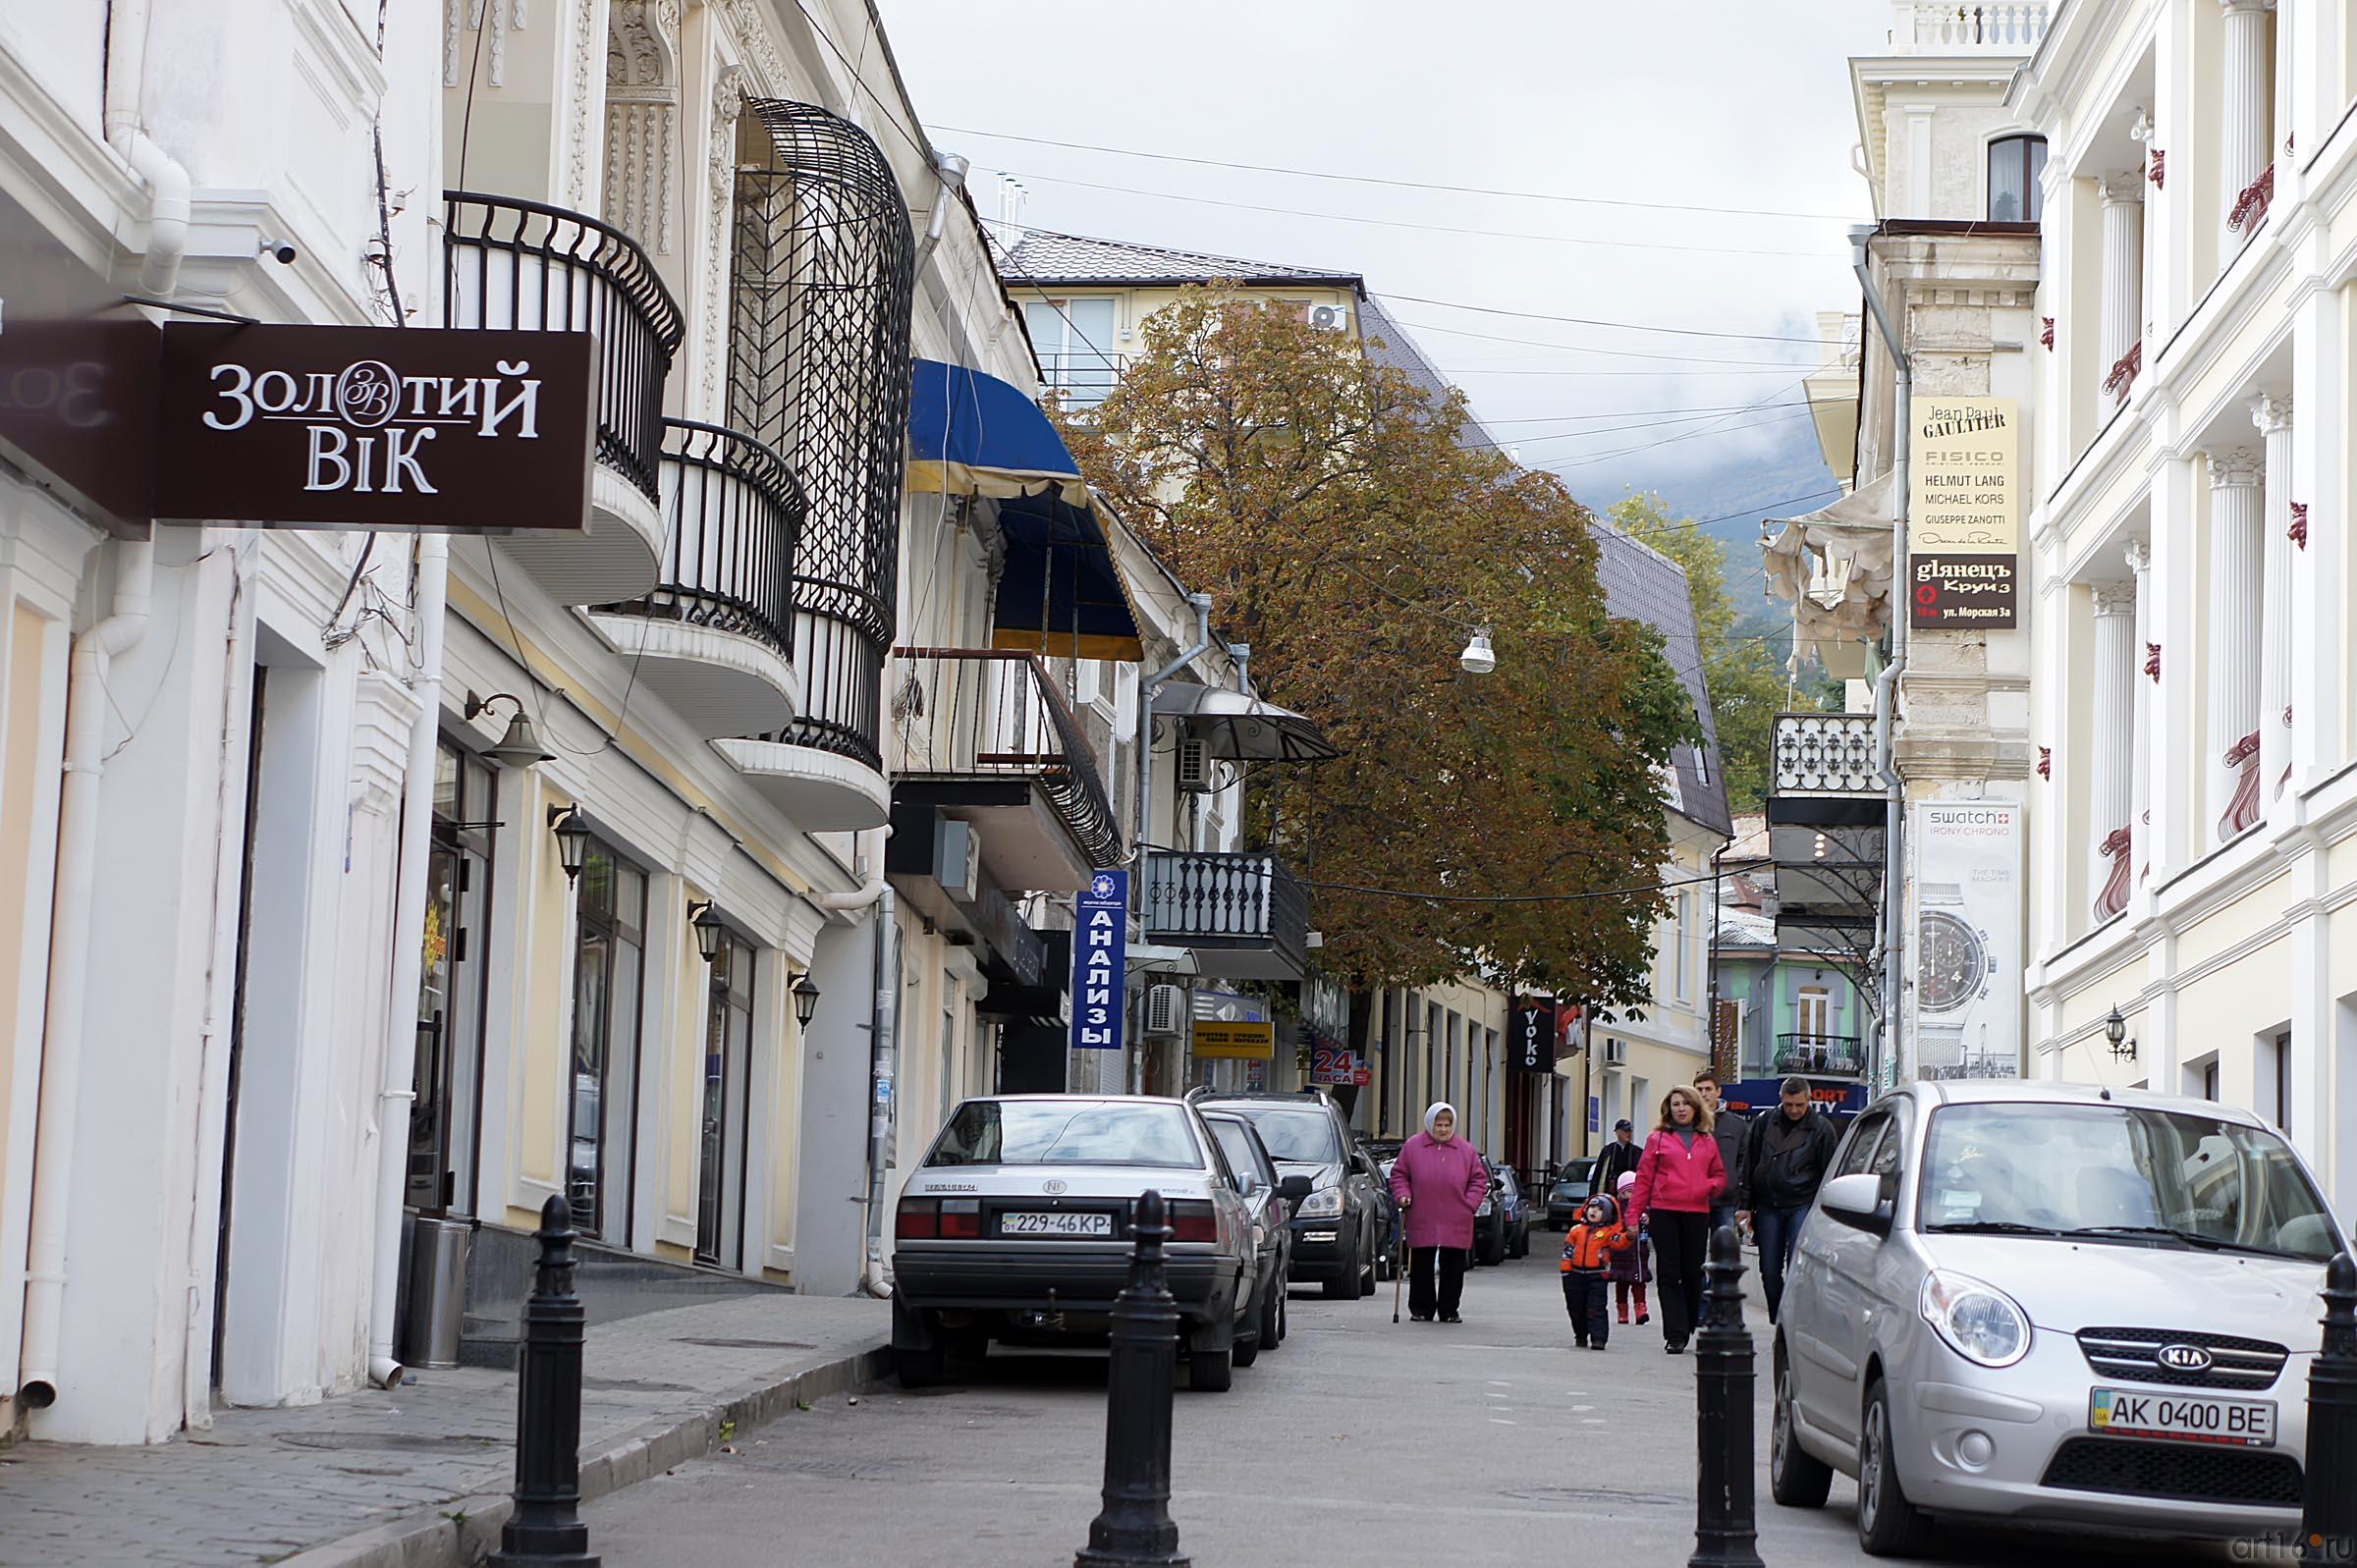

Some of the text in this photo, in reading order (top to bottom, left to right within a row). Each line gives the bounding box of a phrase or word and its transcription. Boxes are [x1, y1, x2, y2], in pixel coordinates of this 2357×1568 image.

[1928, 406, 1999, 420] Jean Paul
[1923, 413, 2005, 439] GAULTIER
[303, 425, 438, 494] ВІК
[1926, 452, 2003, 461] FISICO
[1925, 475, 2004, 487] HELMUT LANG
[1925, 494, 2004, 505] MICHAEL KORS
[1925, 514, 2005, 524] GIUSEPPE ZANOTTI
[1944, 579, 2011, 594] Круиз
[1943, 608, 1957, 620] ул.
[1958, 607, 1998, 620] Морская
[1930, 811, 1997, 824] swatch
[1930, 827, 2010, 837] IRONY CHRONO
[1081, 910, 1114, 1045] АНАЛИЗЫ
[1314, 1051, 1352, 1073] 24
[2167, 1349, 2203, 1365] KIA
[2111, 1397, 2151, 1425] AK
[2159, 1401, 2220, 1430] 0400
[2227, 1406, 2266, 1433] BE
